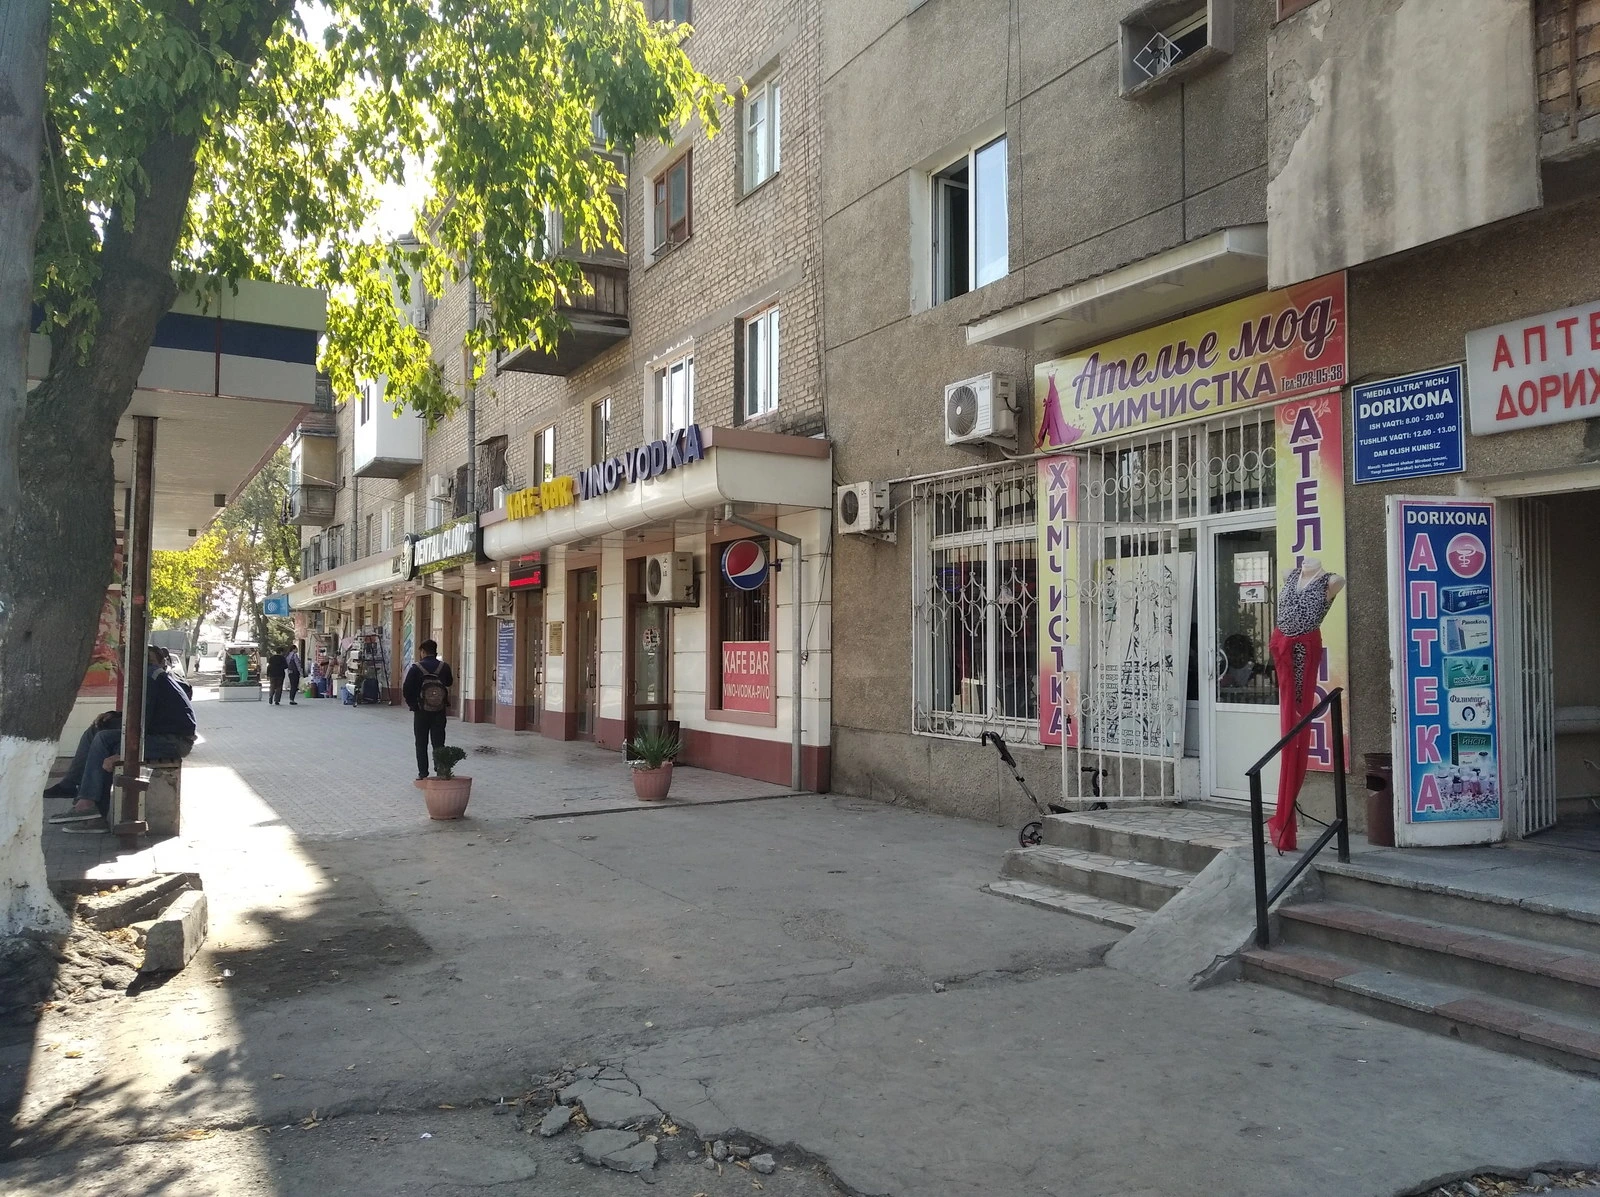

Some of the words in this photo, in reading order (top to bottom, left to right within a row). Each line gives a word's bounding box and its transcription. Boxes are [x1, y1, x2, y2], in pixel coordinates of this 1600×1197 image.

[1072, 331, 1221, 409] Ателье
[1228, 296, 1338, 360] мод
[1425, 376, 1450, 388] MCHJ
[1091, 362, 1277, 436] ХИМЧИСТКА
[1359, 389, 1454, 419] DORIXONA
[1369, 422, 1381, 431] ISH
[1382, 419, 1405, 429] VAQTI:
[1405, 416, 1420, 425] 8.00
[1425, 412, 1445, 421] 20.00
[1359, 436, 1388, 446] TUSHLIK
[1389, 431, 1412, 441] VAQTI:
[1412, 429, 1432, 439] 12.00
[1437, 425, 1457, 434] 13.00
[1373, 450, 1389, 458] DAM
[1389, 446, 1411, 455] OLISH
[1411, 442, 1441, 453] KUNISIZ
[506, 487, 541, 521] KAFE
[540, 475, 574, 512] BAR
[577, 423, 704, 500] VINO-VODKA
[1407, 511, 1488, 525] DORIXONA
[414, 533, 442, 567] DENTAL
[442, 522, 473, 559] CLINIC
[724, 651, 747, 674] KAFE
[750, 651, 769, 675] BAR
[1408, 533, 1442, 812] АПТЕКА
